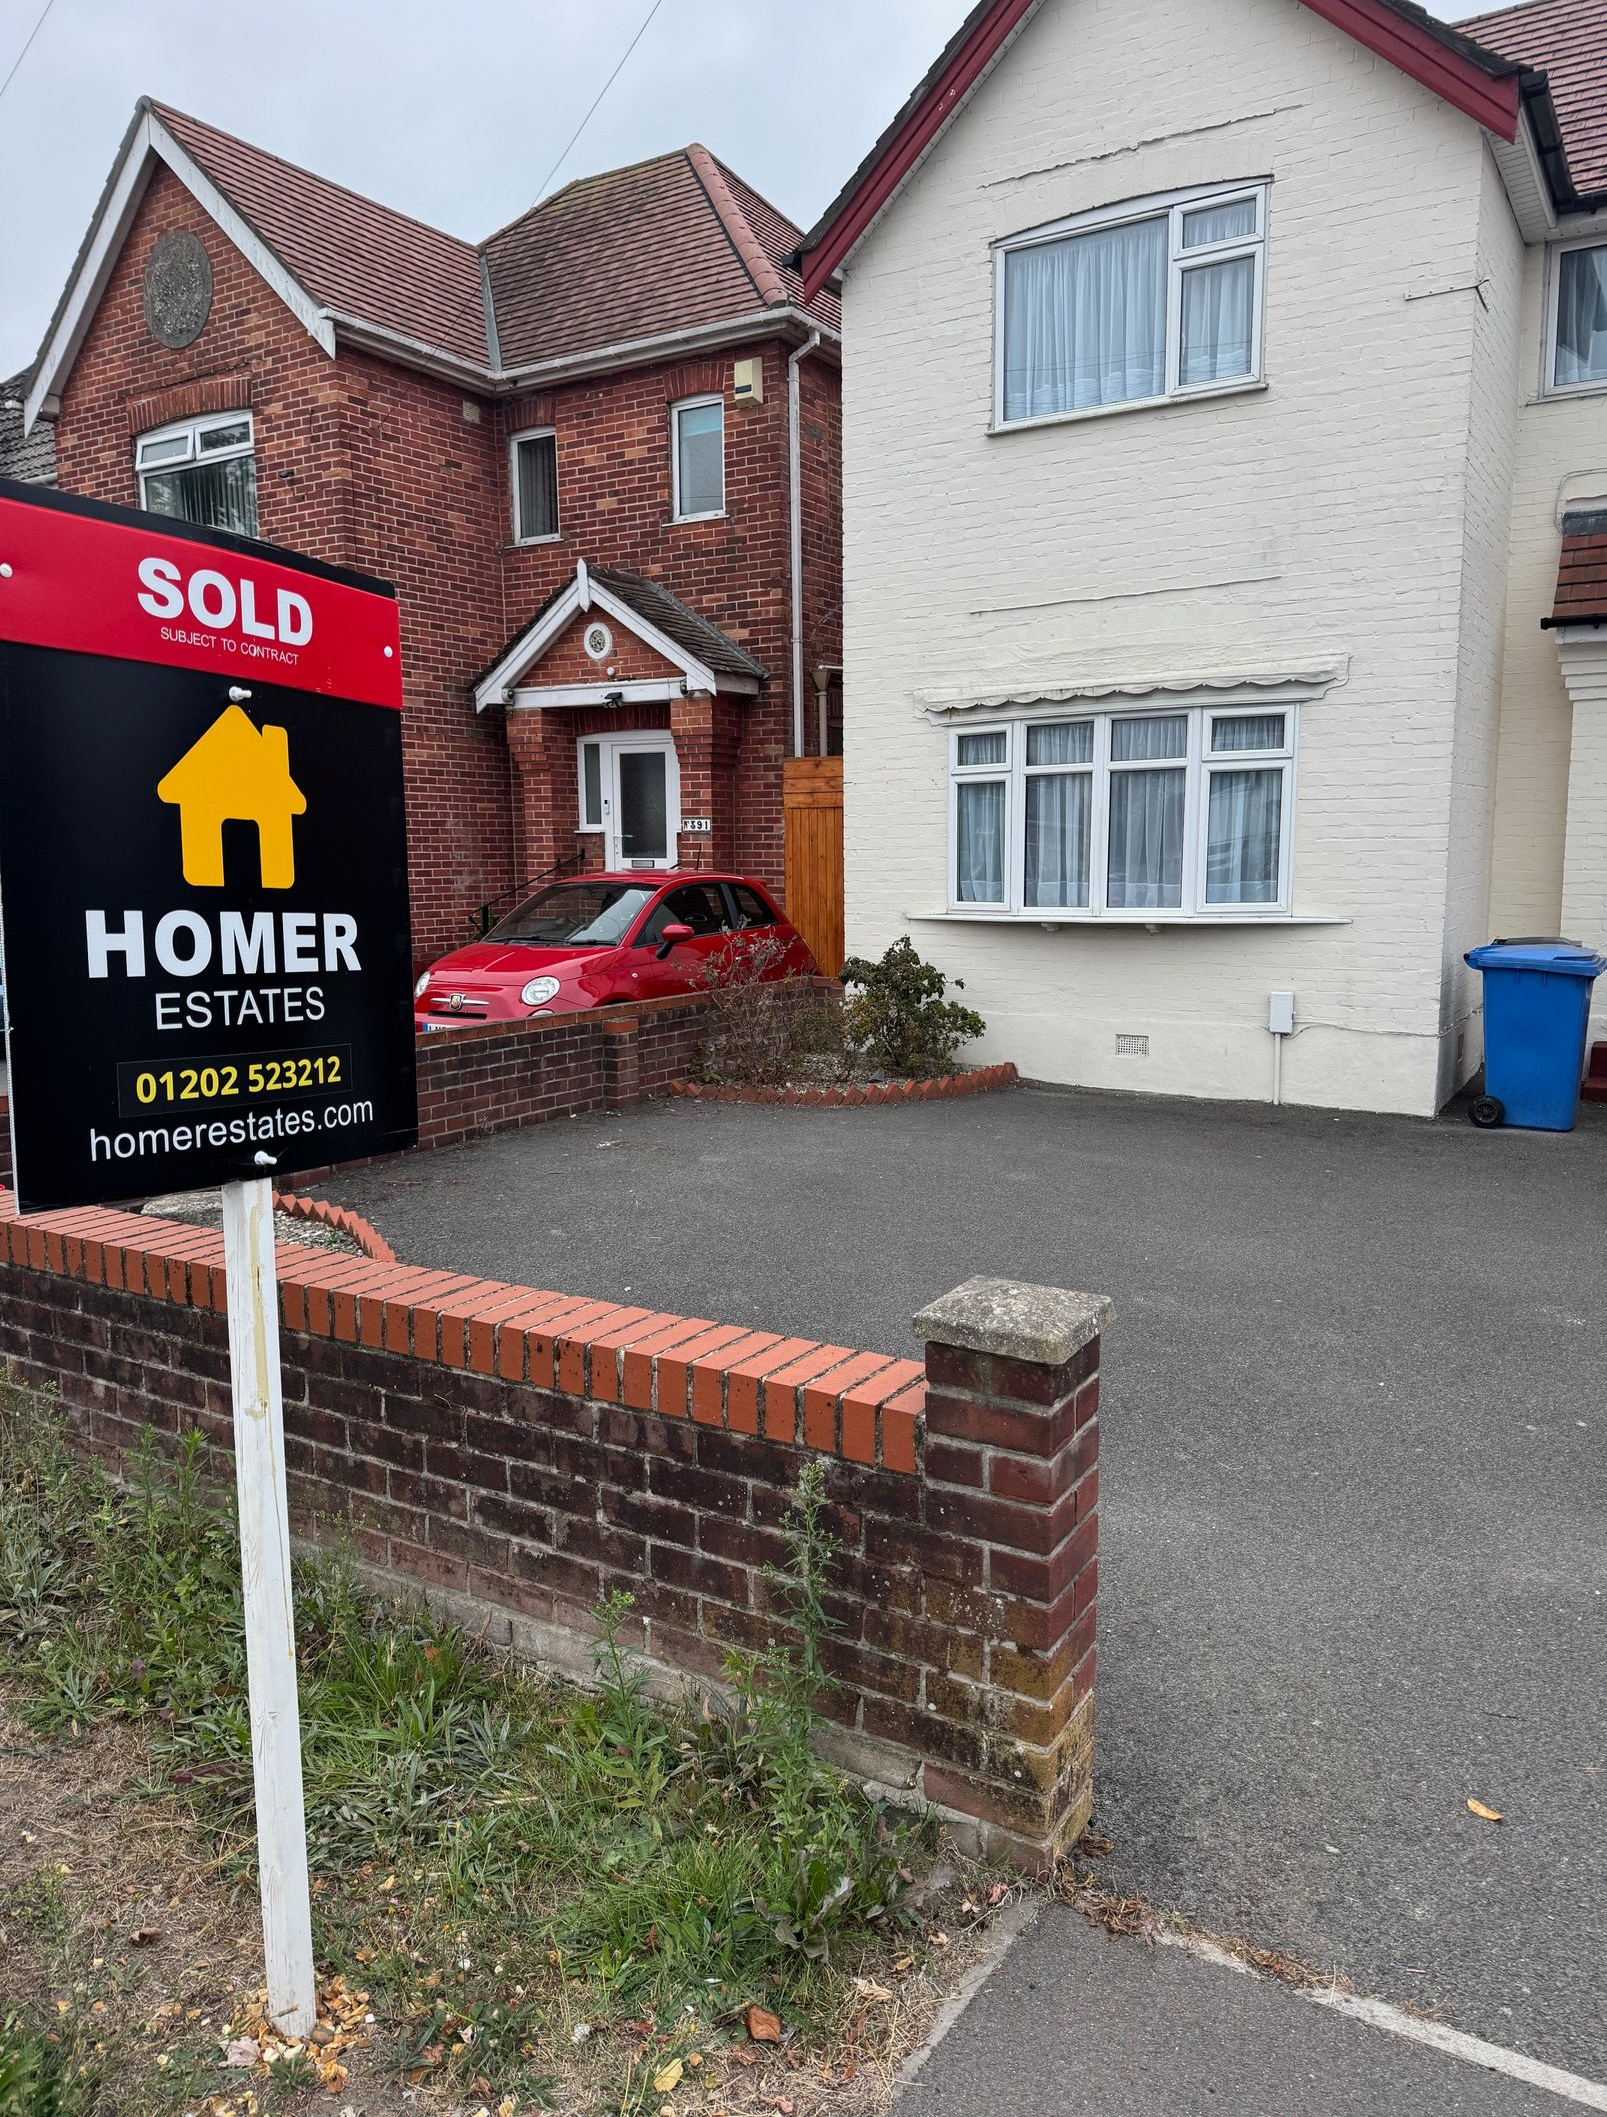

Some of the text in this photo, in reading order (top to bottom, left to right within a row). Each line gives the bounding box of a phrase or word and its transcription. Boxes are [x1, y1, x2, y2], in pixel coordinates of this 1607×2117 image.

[138, 557, 313, 646] SOLD
[160, 627, 299, 665] SUBJECT TO CONTRACT
[690, 820, 708, 830] 391
[86, 910, 361, 978] HOMER
[156, 987, 325, 1030] ESTATES
[136, 1055, 341, 1103] 01202 523212
[90, 1100, 374, 1161] homerestates.com
